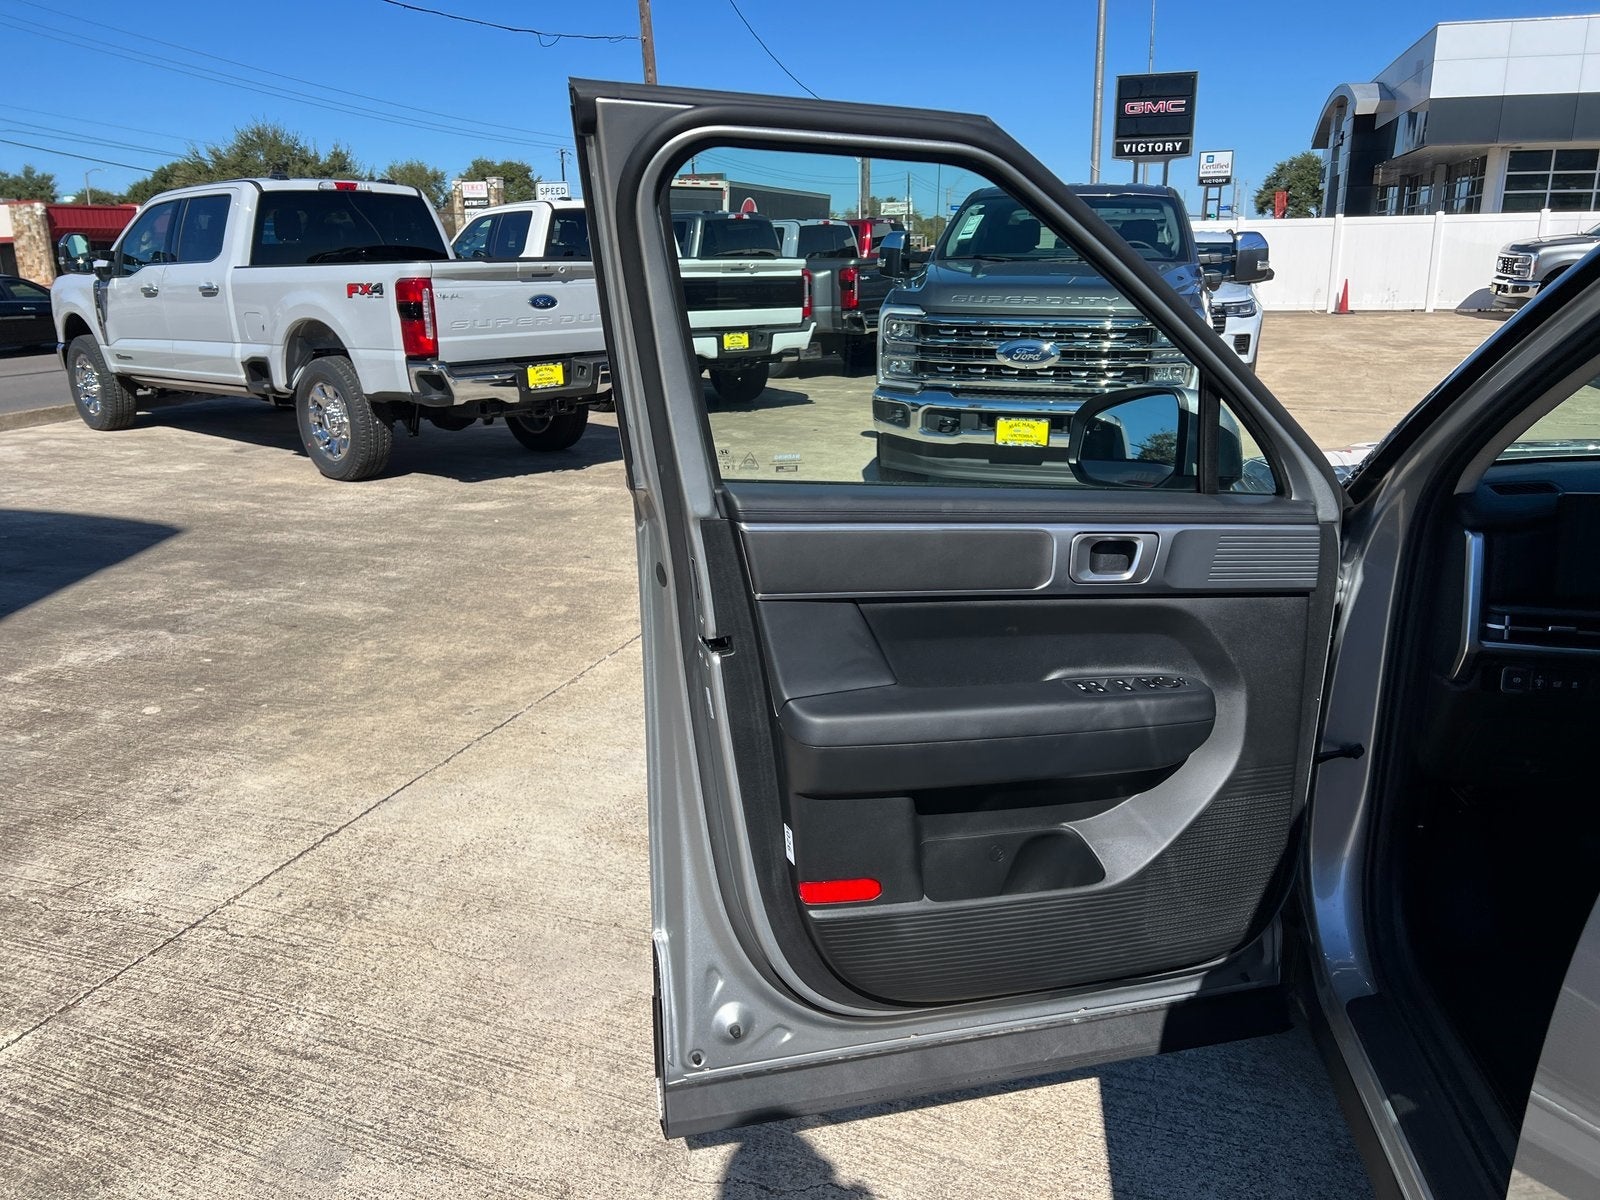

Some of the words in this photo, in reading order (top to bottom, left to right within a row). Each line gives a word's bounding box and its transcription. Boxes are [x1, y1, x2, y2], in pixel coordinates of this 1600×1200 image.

[1124, 100, 1186, 115] GMC
[1123, 142, 1182, 153] VICTORY
[1201, 162, 1230, 170] Certified
[539, 186, 567, 196] SPEED
[346, 283, 384, 298] FX4
[951, 294, 1040, 305] SUPER
[1046, 296, 1119, 305] DUTY
[451, 316, 553, 331] SUPER
[1012, 347, 1043, 361] Ford
